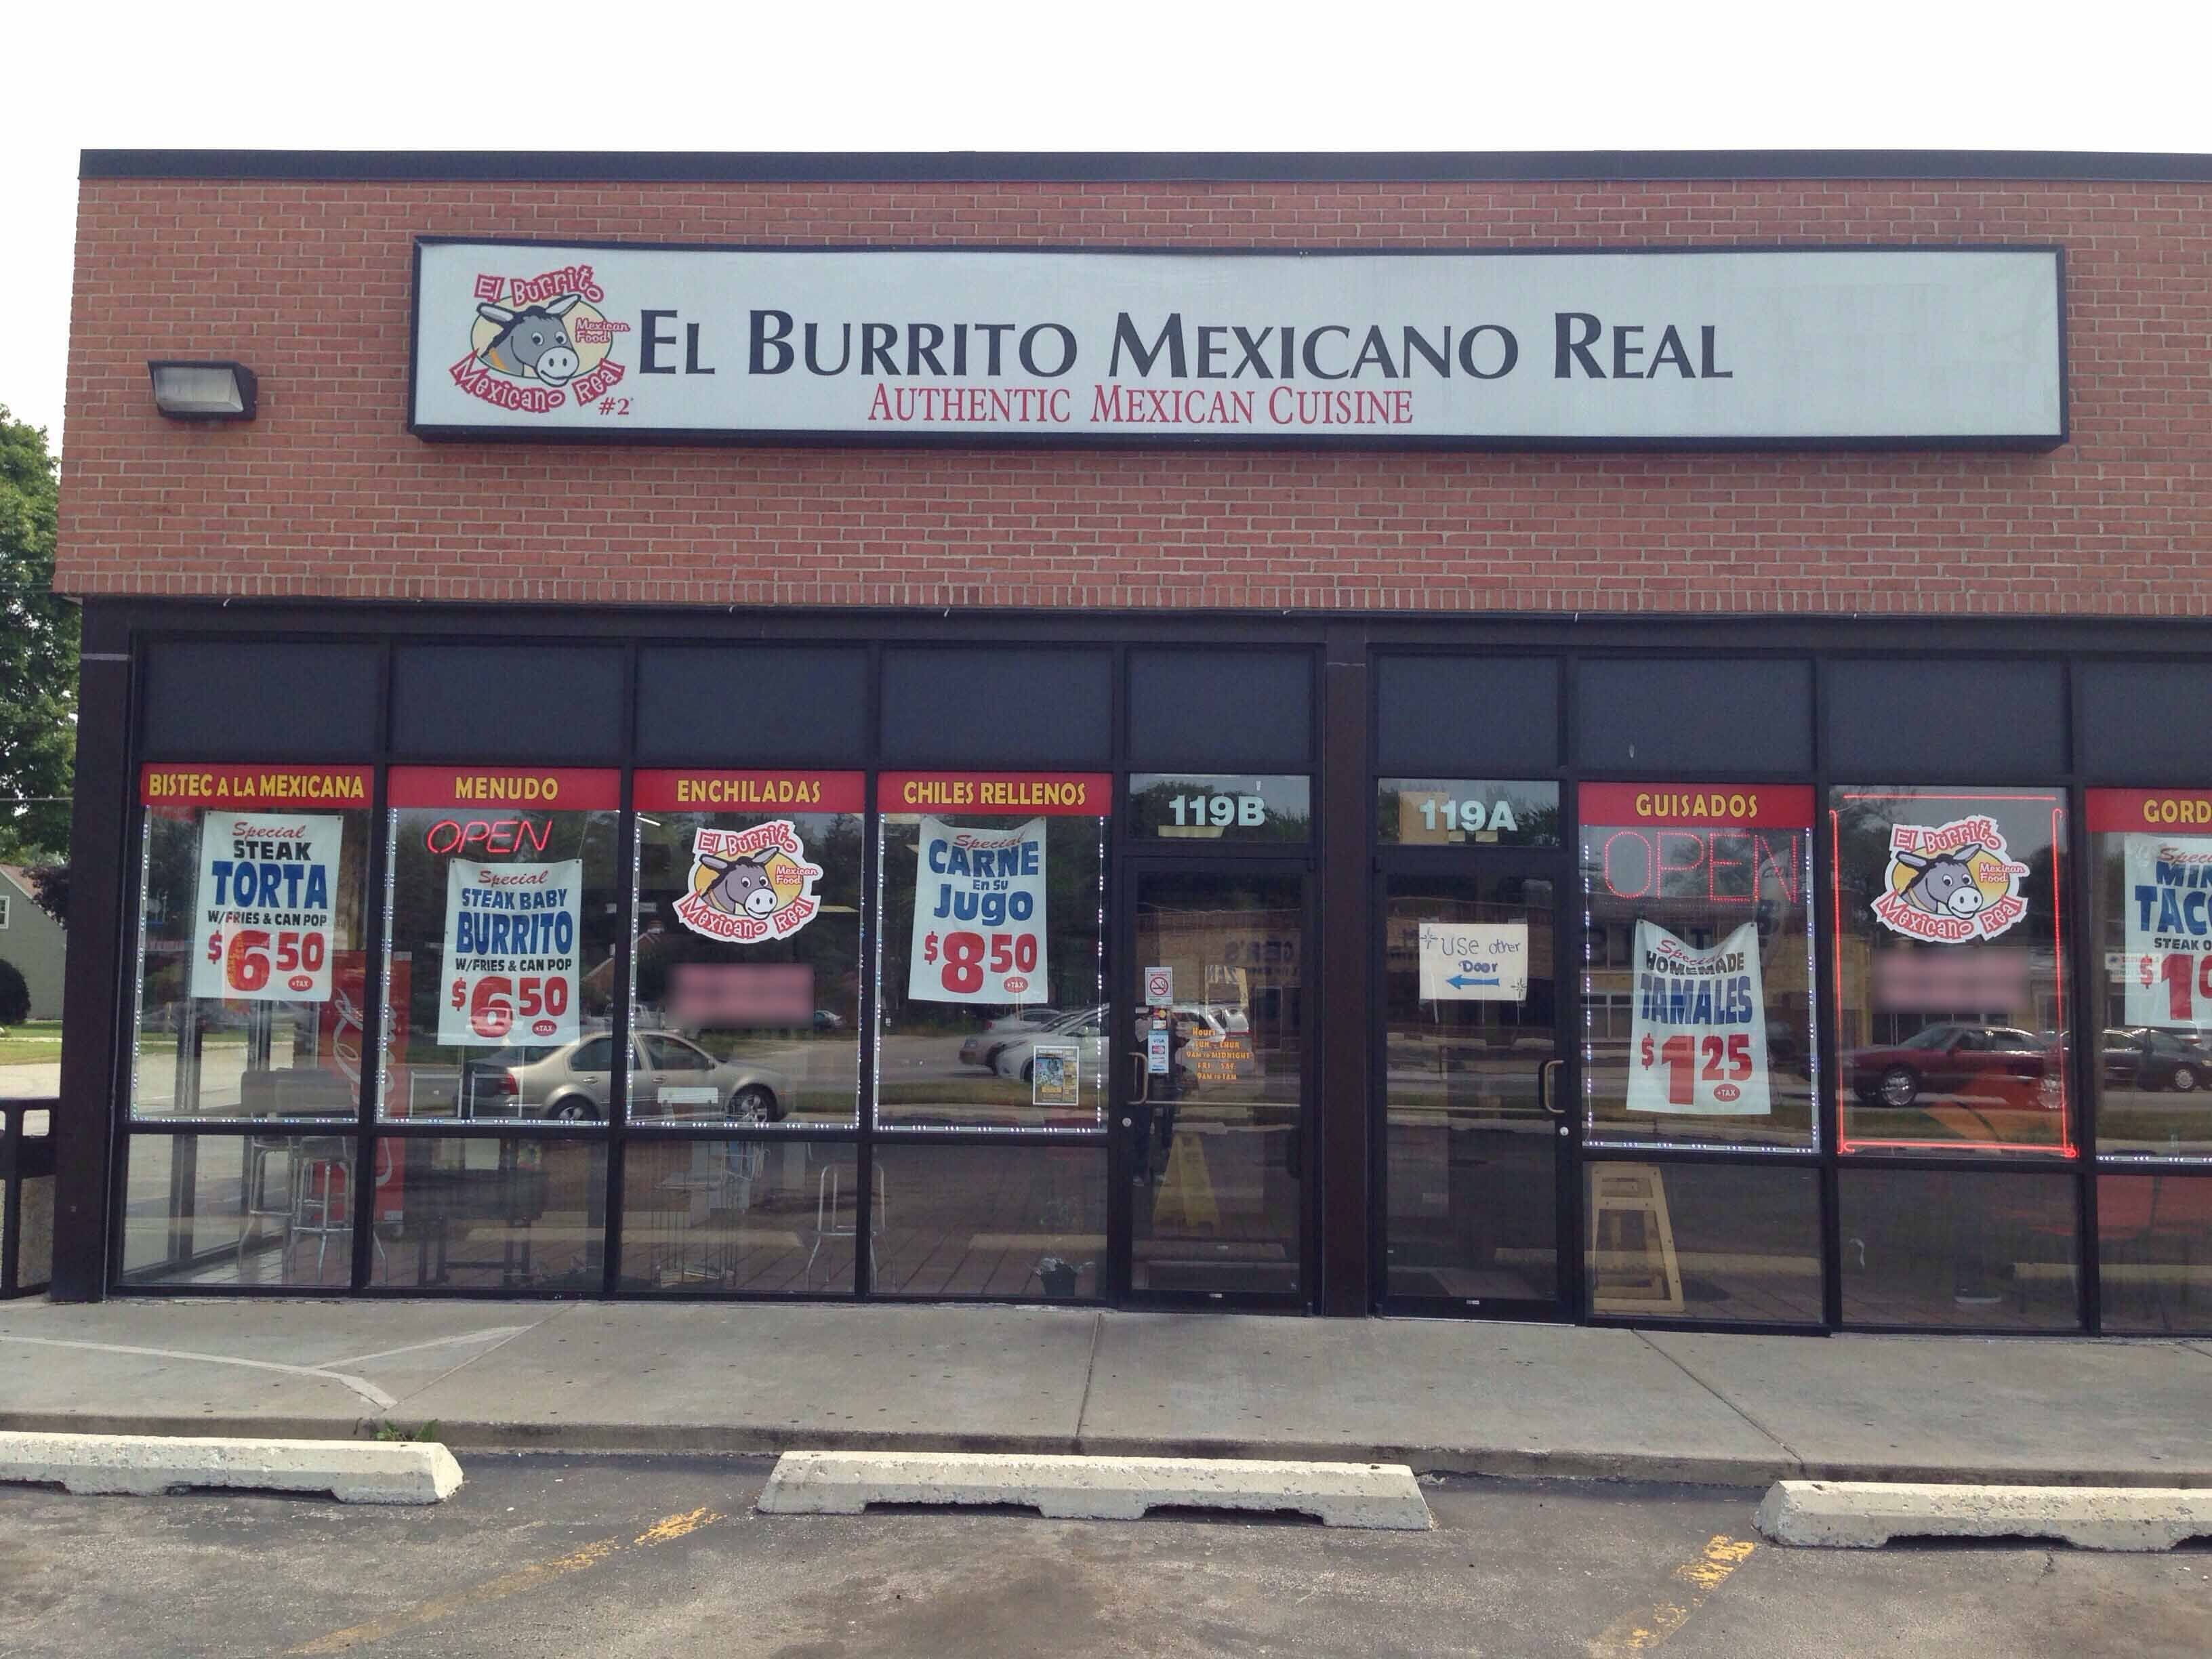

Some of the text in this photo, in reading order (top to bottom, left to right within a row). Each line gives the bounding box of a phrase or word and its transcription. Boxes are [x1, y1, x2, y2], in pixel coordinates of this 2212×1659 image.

[474, 264, 604, 306] El Burrito
[575, 316, 630, 332] Mexican
[575, 330, 610, 344] Food
[639, 309, 1733, 380] EL BURRITO MEXICANO REAL
[449, 347, 625, 413] Mexicano Real
[598, 396, 630, 415] #2
[867, 382, 1414, 426] AUTHENTIC MEXICAN CUISINE
[148, 774, 365, 798] BISTEC A LA MEXICANA
[455, 776, 558, 800] MENUDO
[677, 779, 821, 803] ENCHILADAS
[903, 781, 1086, 805] CHILES RELLENOS
[1169, 795, 1266, 827] 119B
[1420, 798, 1518, 831] 119A
[1635, 792, 1758, 819] GUISADOS
[232, 821, 306, 840] Special
[426, 818, 553, 854] OPEN
[698, 823, 797, 857] El Burrito
[953, 831, 1025, 850] Special
[1893, 819, 2001, 854] El Burrito
[233, 840, 312, 861] STEAK
[929, 839, 1039, 878] CARNE
[478, 870, 549, 887] Special
[775, 865, 818, 876] Mexican
[1603, 830, 1798, 903] OPEN
[1979, 862, 2025, 874] Mexican
[1979, 872, 2009, 882] Food
[211, 860, 328, 909] TORTA
[775, 875, 802, 884] Food
[462, 888, 568, 910] STEAK BABY
[2135, 885, 2212, 936] TAC
[207, 910, 327, 926] W/FRIES & CAN POP
[678, 889, 814, 939] Mexicano Real
[1876, 888, 2022, 939] Mexicano Real
[456, 911, 573, 955] BURRITO
[2154, 938, 2199, 950] STEAK
[1488, 939, 1521, 955] other
[455, 958, 572, 972] W/FRIES & CAN POP
[1458, 960, 1498, 973] Door
[1645, 950, 1745, 975] HOMEMADE
[1640, 973, 1753, 1025] TAMALES
